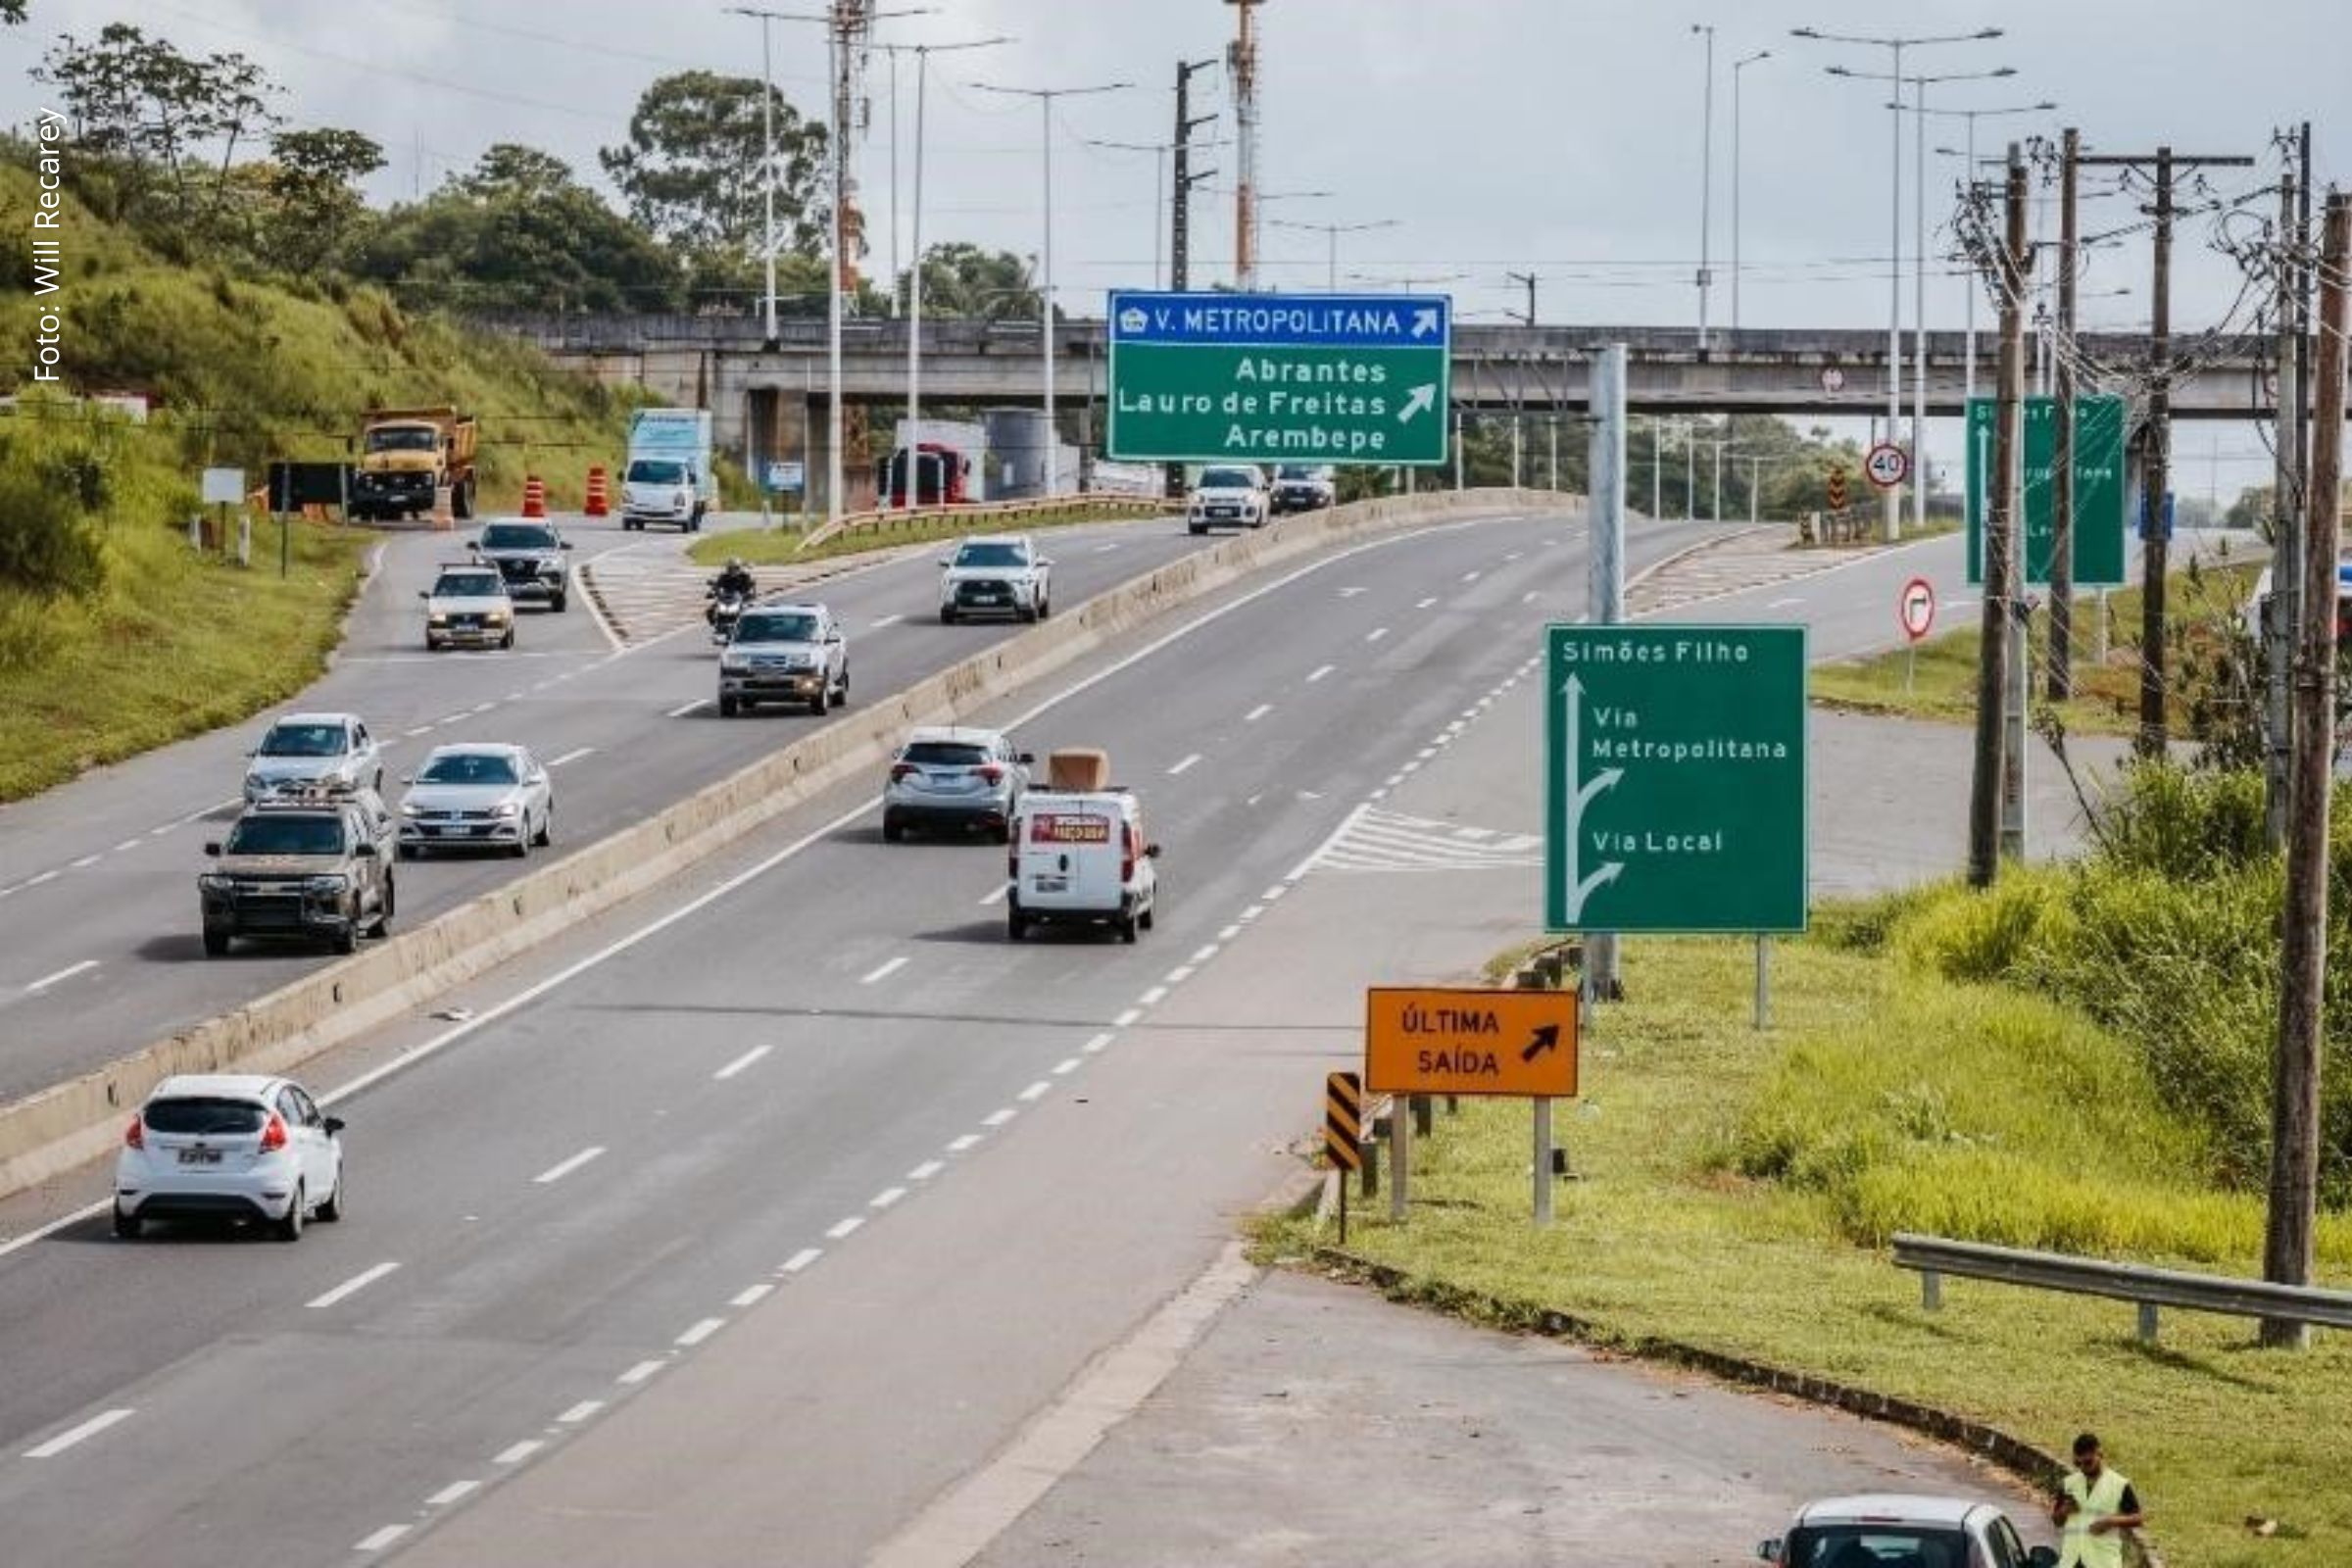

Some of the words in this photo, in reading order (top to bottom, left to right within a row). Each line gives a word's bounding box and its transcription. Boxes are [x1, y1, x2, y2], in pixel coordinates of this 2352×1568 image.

[1154, 309, 1177, 332] V.
[1184, 309, 1400, 333] METROPOLITANA
[1236, 358, 1387, 383] Abrantes
[1119, 389, 1212, 414] Lauro
[1222, 391, 1257, 415] de
[1269, 392, 1387, 416] Freitas
[1225, 424, 1387, 453] Arembepe
[1873, 454, 1899, 471] 40
[1562, 640, 1667, 662] Simões
[1675, 641, 1749, 662] Filho
[1592, 707, 1639, 728] Via
[1592, 738, 1788, 762] Metropolitana
[1592, 831, 1637, 852] Via
[1645, 830, 1723, 852] Local
[1402, 1002, 1499, 1034] ÚLTIMA
[1418, 1044, 1500, 1075] SAÍDA
